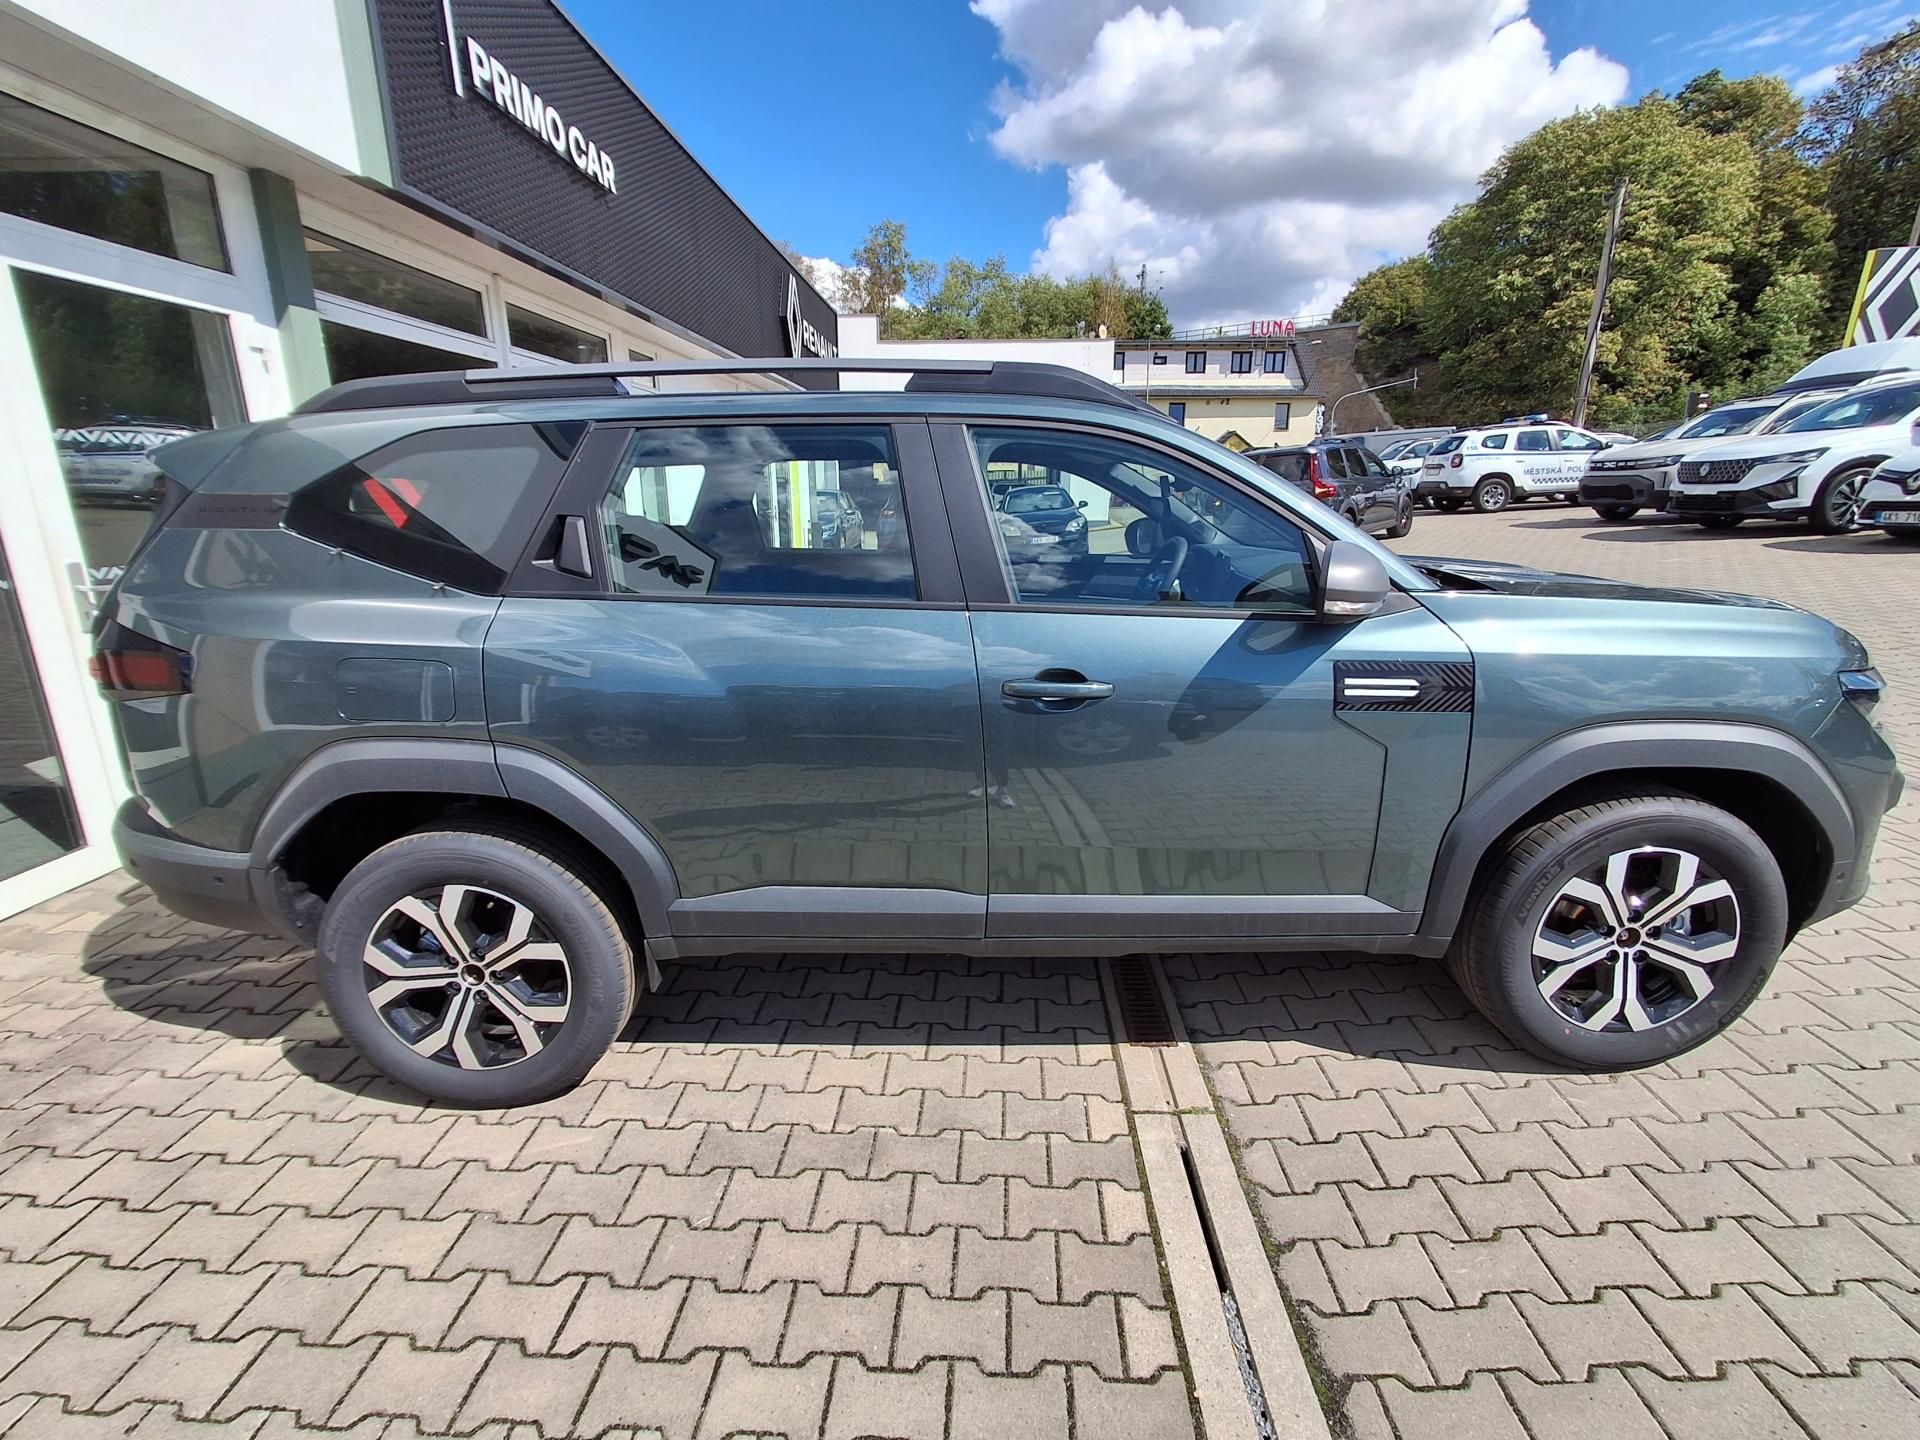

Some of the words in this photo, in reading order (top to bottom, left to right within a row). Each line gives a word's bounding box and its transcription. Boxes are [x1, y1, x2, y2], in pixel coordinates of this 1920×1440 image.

[466, 36, 567, 154] PRIMO
[568, 125, 617, 195] CAR
[1250, 319, 1296, 337] LUNA
